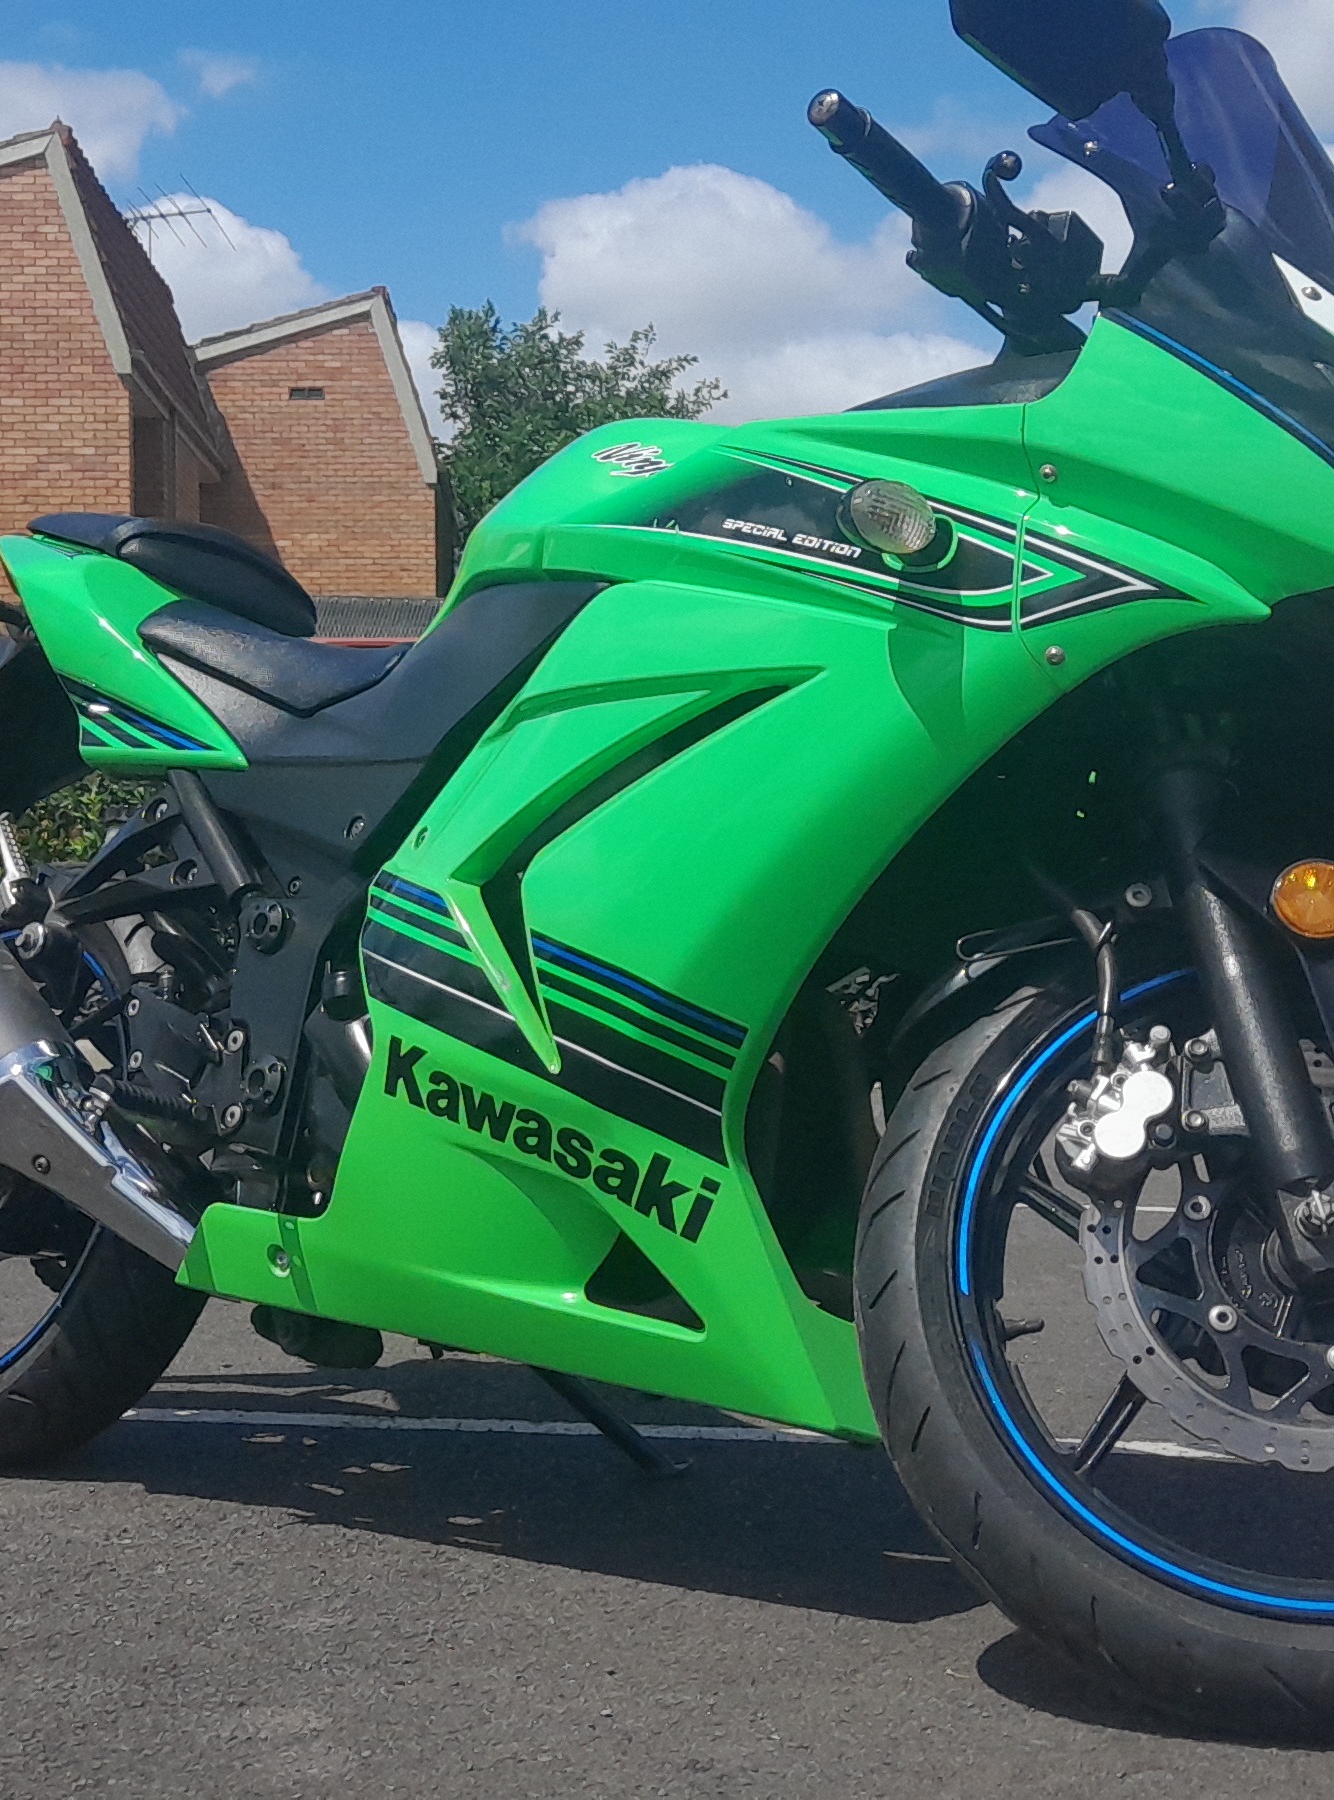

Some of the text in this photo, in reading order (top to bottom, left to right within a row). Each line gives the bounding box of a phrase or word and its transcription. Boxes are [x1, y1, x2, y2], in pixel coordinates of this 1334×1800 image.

[722, 518, 862, 559] SPECIAL EDITION
[383, 1034, 722, 1243] Kawasaki
[925, 1073, 992, 1218] DIABLO
